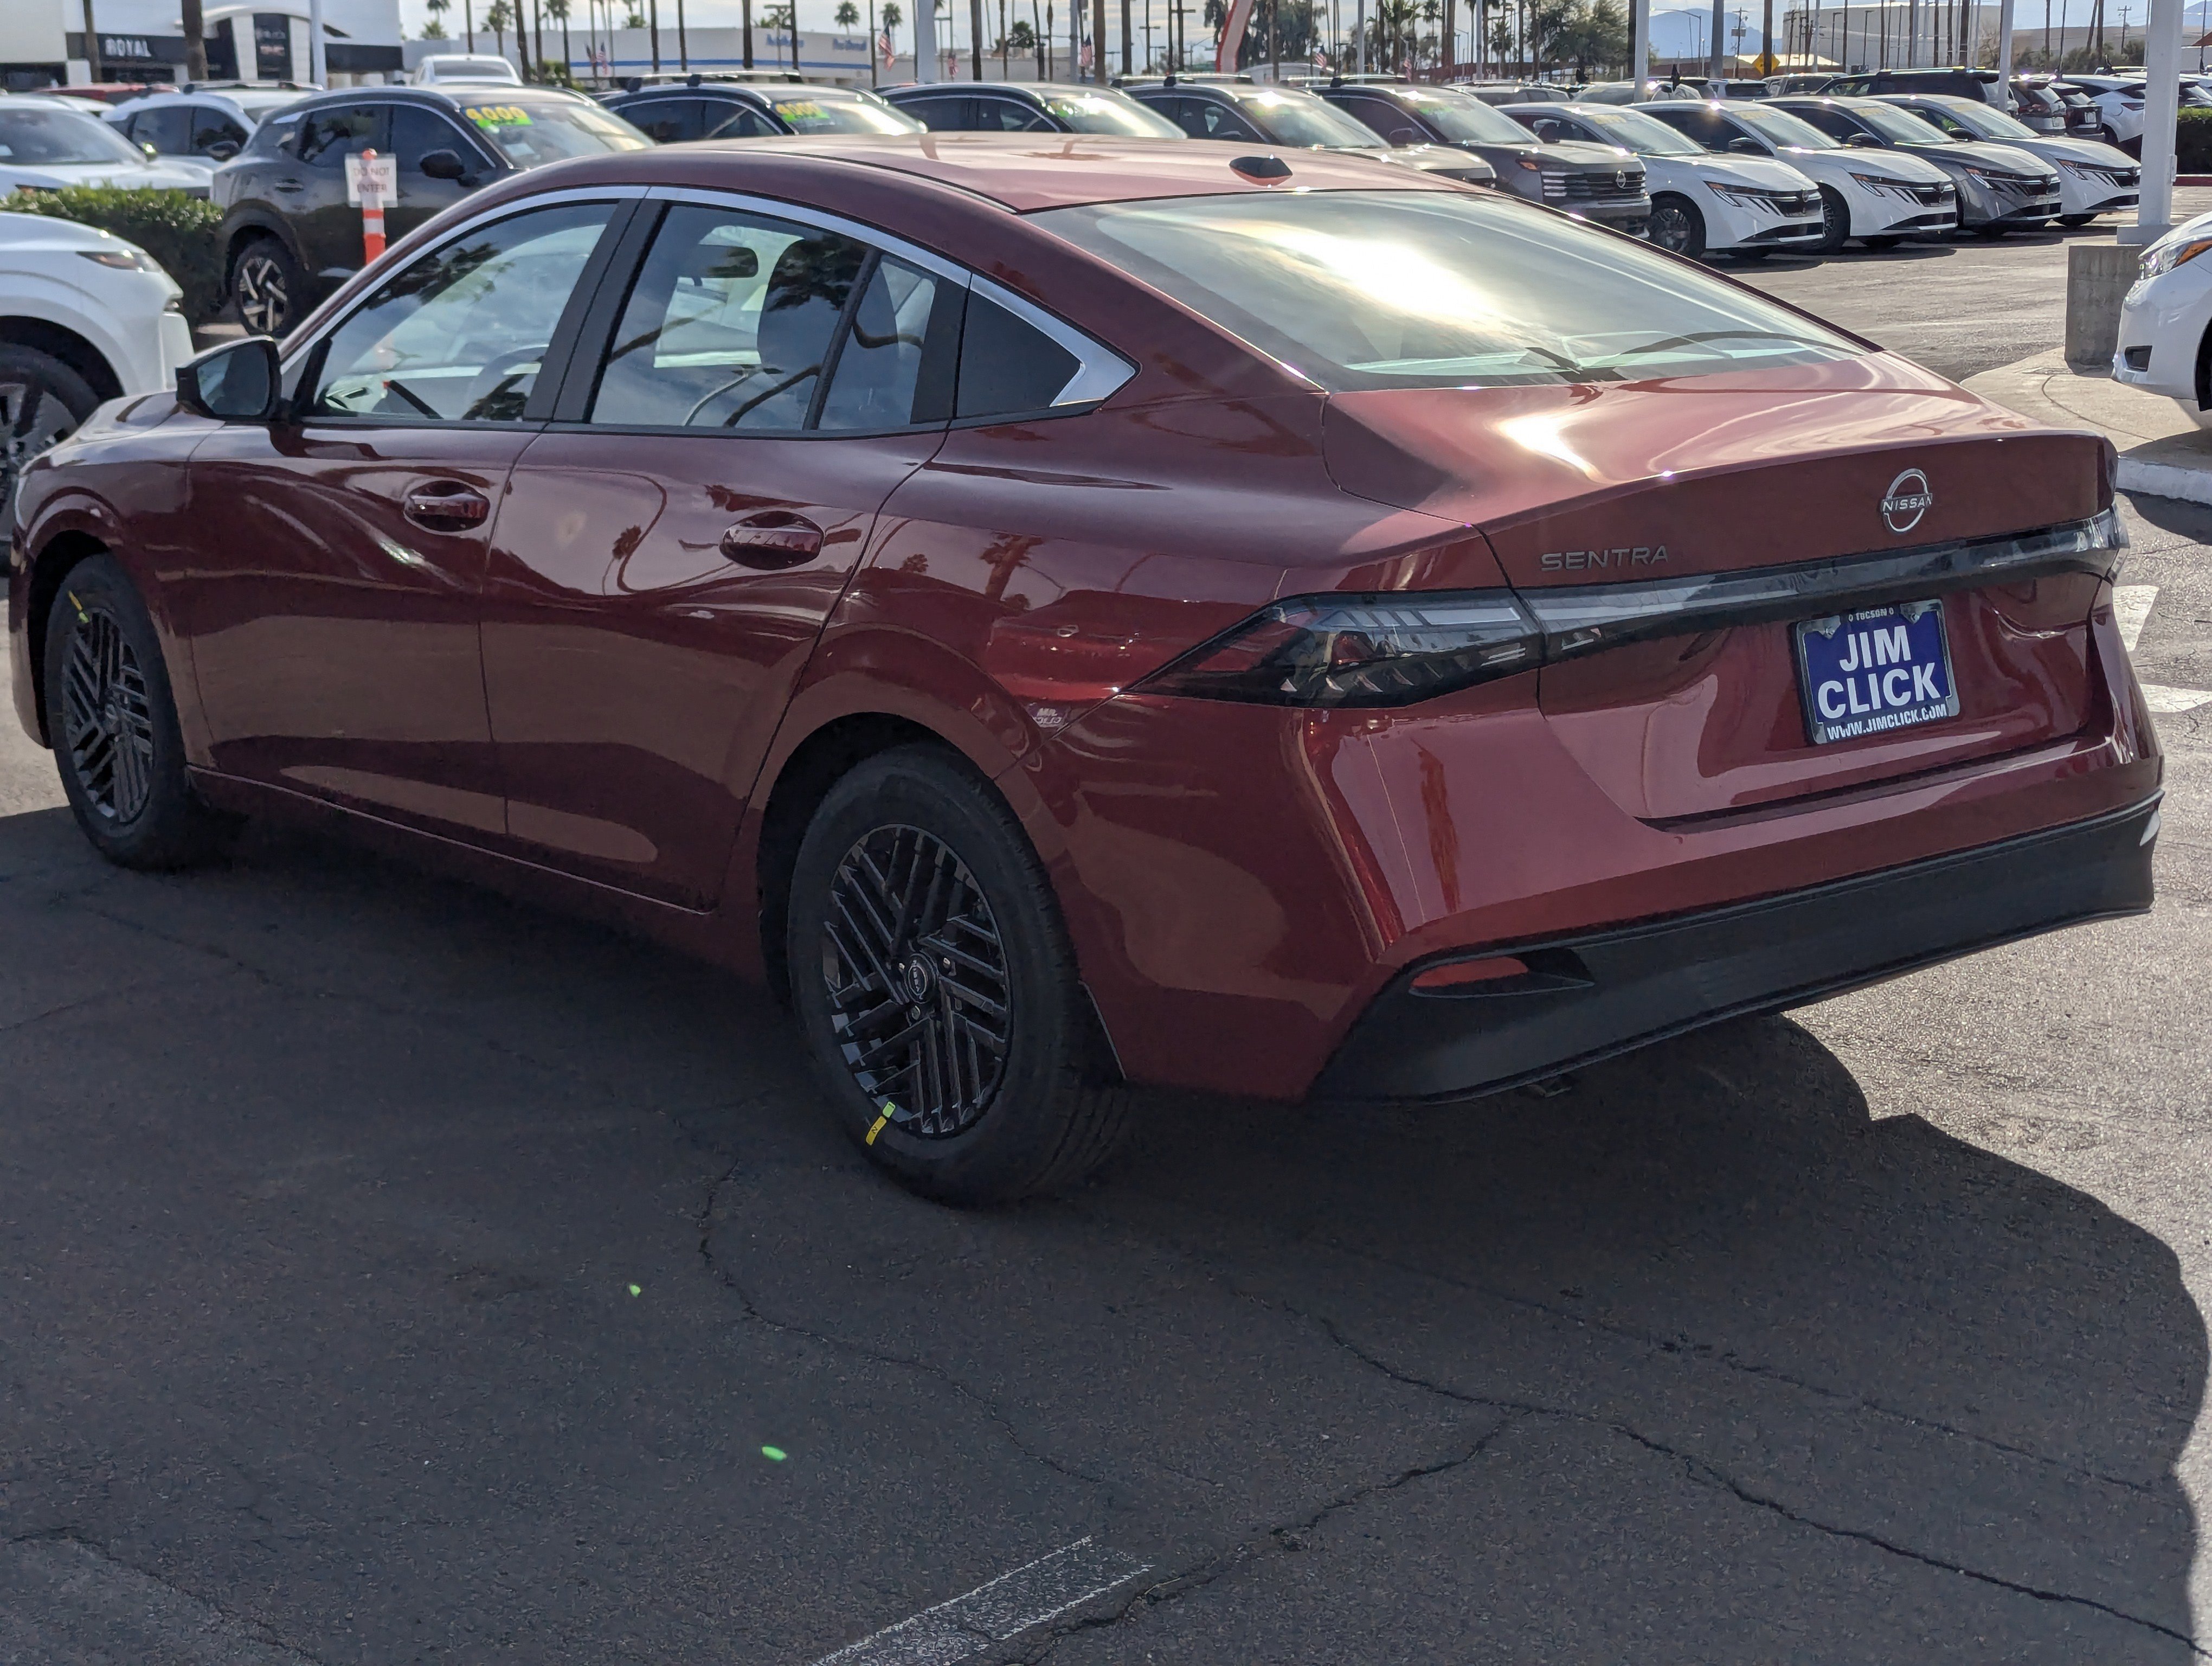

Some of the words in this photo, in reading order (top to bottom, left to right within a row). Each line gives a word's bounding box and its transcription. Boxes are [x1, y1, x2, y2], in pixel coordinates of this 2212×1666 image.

[105, 37, 152, 57] ROYAL
[353, 166, 368, 176] DO
[370, 166, 390, 176] NOT
[357, 183, 387, 193] ENTER
[1882, 496, 1932, 512] NISSAN
[1541, 545, 1669, 572] SENTRA
[1855, 607, 1887, 621] TUCSON
[1839, 625, 1912, 672] JIM
[1817, 662, 1941, 719] CLICK
[1826, 703, 1949, 740] WWW.JIMCLICK.COM
